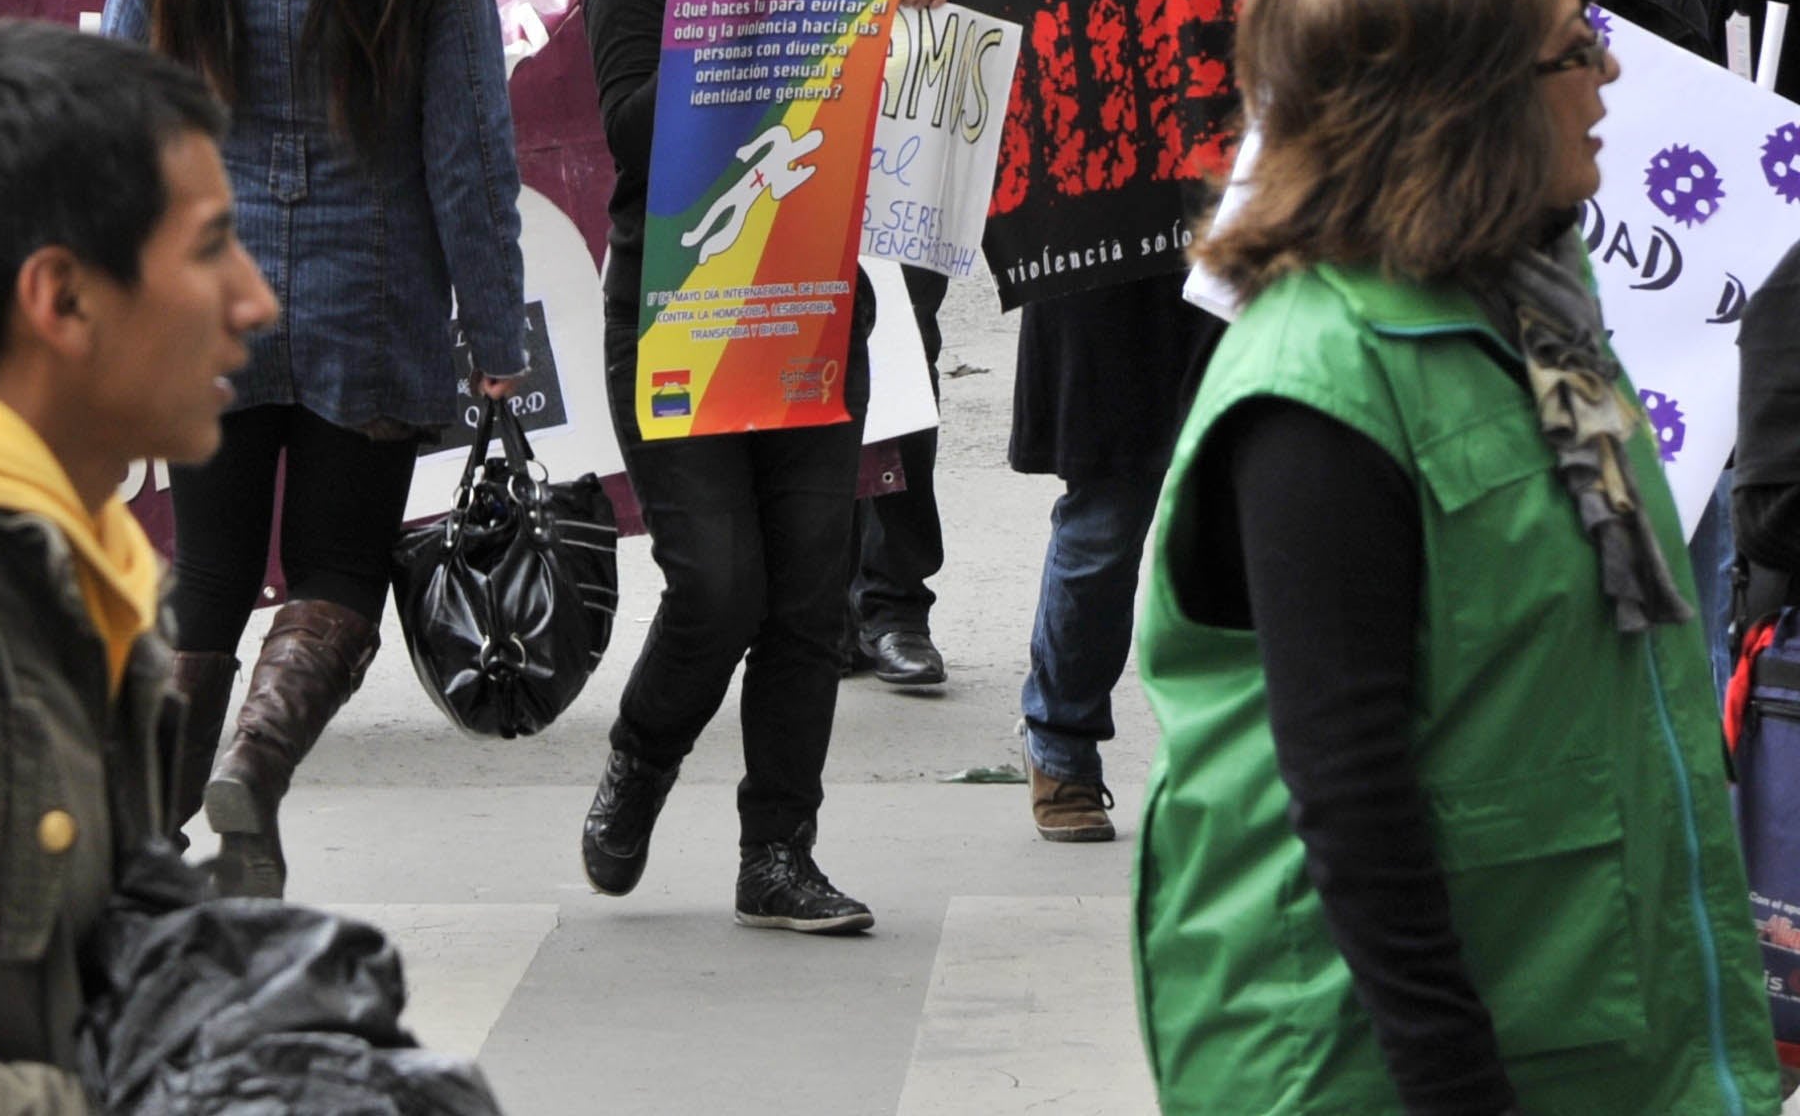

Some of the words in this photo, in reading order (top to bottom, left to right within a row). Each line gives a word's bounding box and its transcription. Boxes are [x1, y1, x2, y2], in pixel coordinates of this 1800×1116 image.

[711, 0, 751, 17] haces
[673, 24, 704, 41] odio
[707, 28, 718, 43] y
[720, 22, 735, 39] la
[736, 18, 797, 38] violencia
[801, 17, 849, 35] hacia
[852, 20, 880, 36] las
[693, 44, 754, 64] personas
[755, 42, 781, 58] con
[784, 40, 849, 58] diversa
[694, 62, 769, 84] orientación
[772, 62, 828, 79] sexual
[830, 64, 843, 78] e
[689, 84, 752, 107] identidad
[754, 83, 772, 101] de
[774, 83, 844, 105] género?
[1580, 197, 1684, 292] DAD
[1007, 235, 1125, 286] violencia
[673, 288, 702, 303] MAYO
[722, 283, 797, 300] INTERNACIONAL
[798, 281, 814, 295] DE
[812, 280, 850, 295] LUCHA
[656, 308, 695, 325] CONTRA
[696, 307, 711, 321] LA
[689, 325, 751, 342] TRANSFOBIA
[750, 325, 760, 339] Y
[758, 321, 800, 338] BIFOBIA
